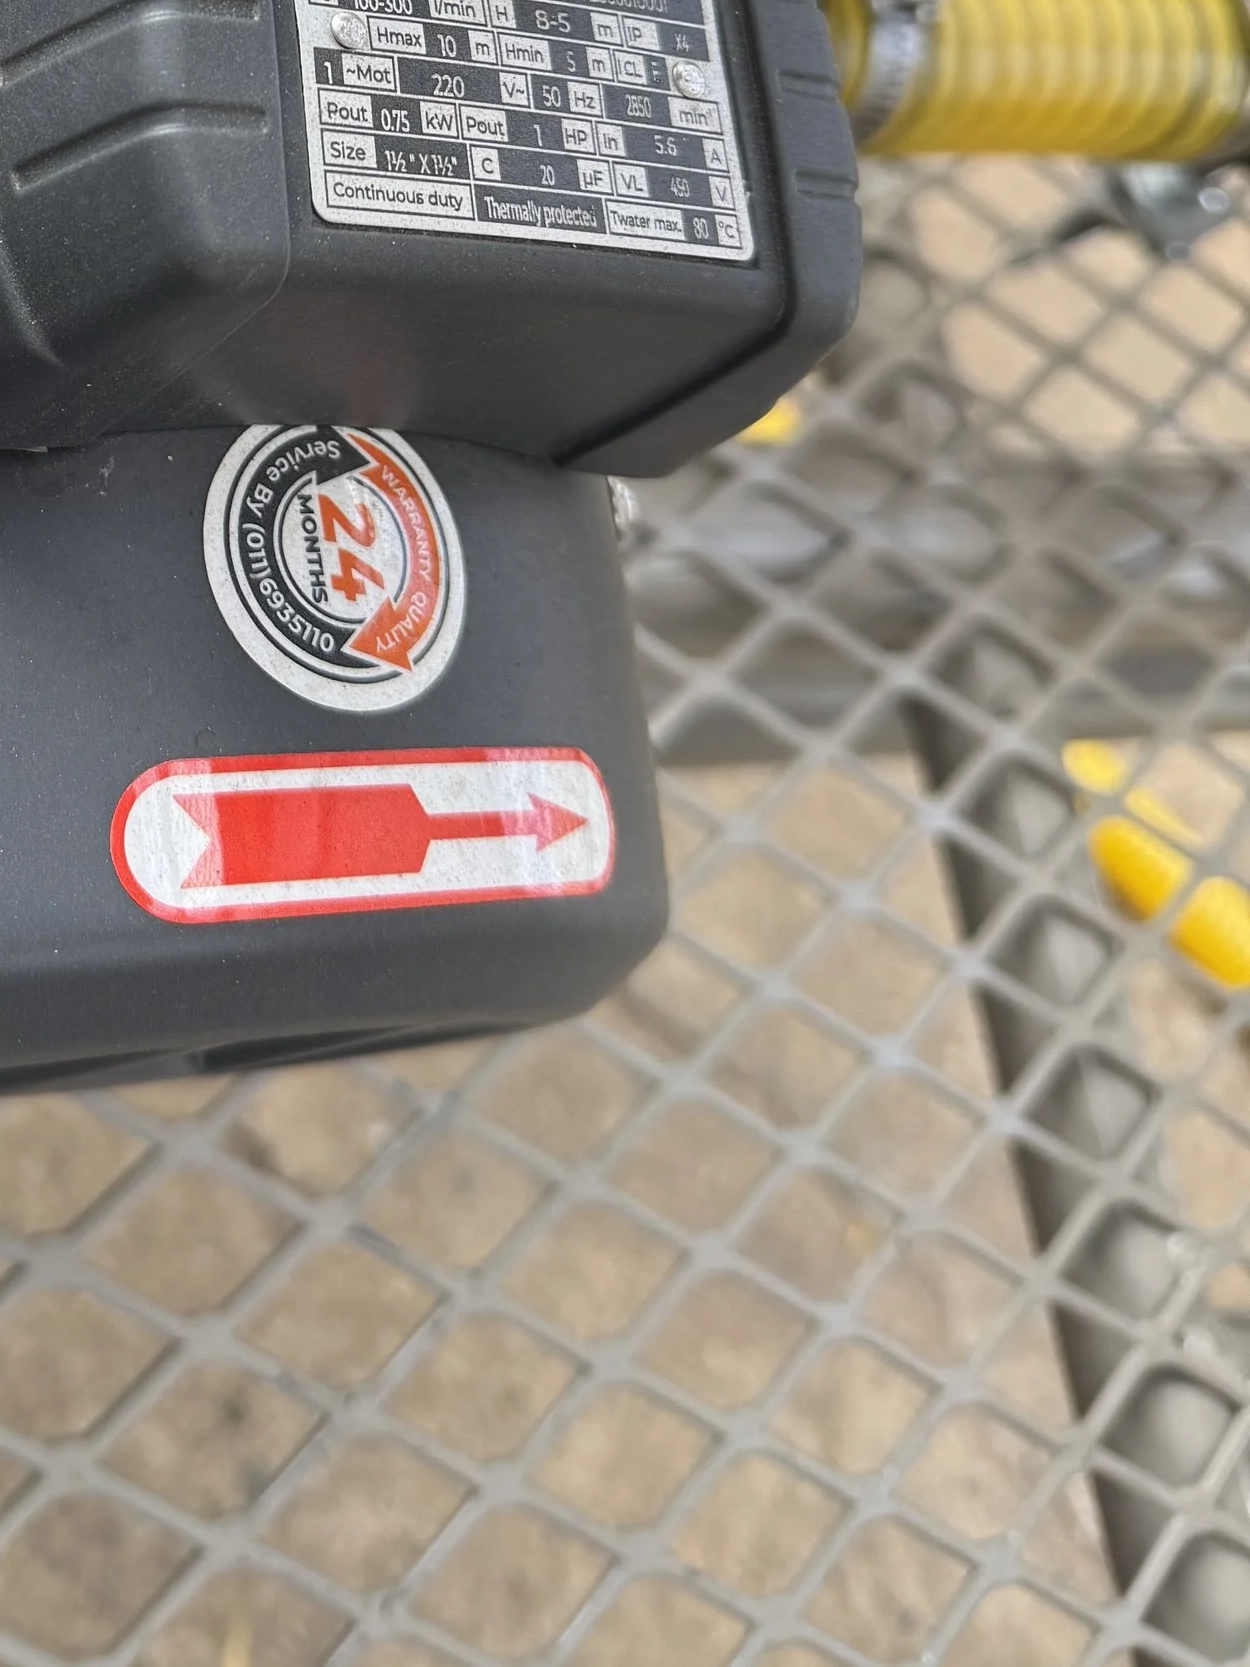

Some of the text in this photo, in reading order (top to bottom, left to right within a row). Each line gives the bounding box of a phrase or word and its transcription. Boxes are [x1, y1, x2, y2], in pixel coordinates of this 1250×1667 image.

[376, 26, 423, 48] Hmax
[437, 34, 457, 58] 10
[475, 41, 491, 56] m
[505, 43, 544, 64] Hmin
[592, 59, 605, 73] m
[496, 5, 508, 22] H
[598, 24, 614, 37] m
[627, 26, 643, 41] IP
[323, 61, 333, 84] 1
[431, 73, 465, 98] 220
[542, 85, 561, 108] 50
[574, 92, 595, 110] Hz
[625, 94, 652, 119] 2850
[326, 102, 723, 165] Pout 0.75 kW Pout 1 HP In 5.6 A
[330, 141, 367, 161] Size
[481, 157, 494, 175] C
[539, 164, 555, 186] 20
[620, 173, 644, 192] VL
[715, 184, 728, 202] V
[333, 182, 735, 239] Continuous duty Thermally protected Twater max. 80 °C
[242, 440, 341, 652] Service By (011)6935110
[296, 494, 328, 604] MONTHS
[317, 493, 385, 602] 24
[376, 464, 433, 653] WARRANTY QUALITY
